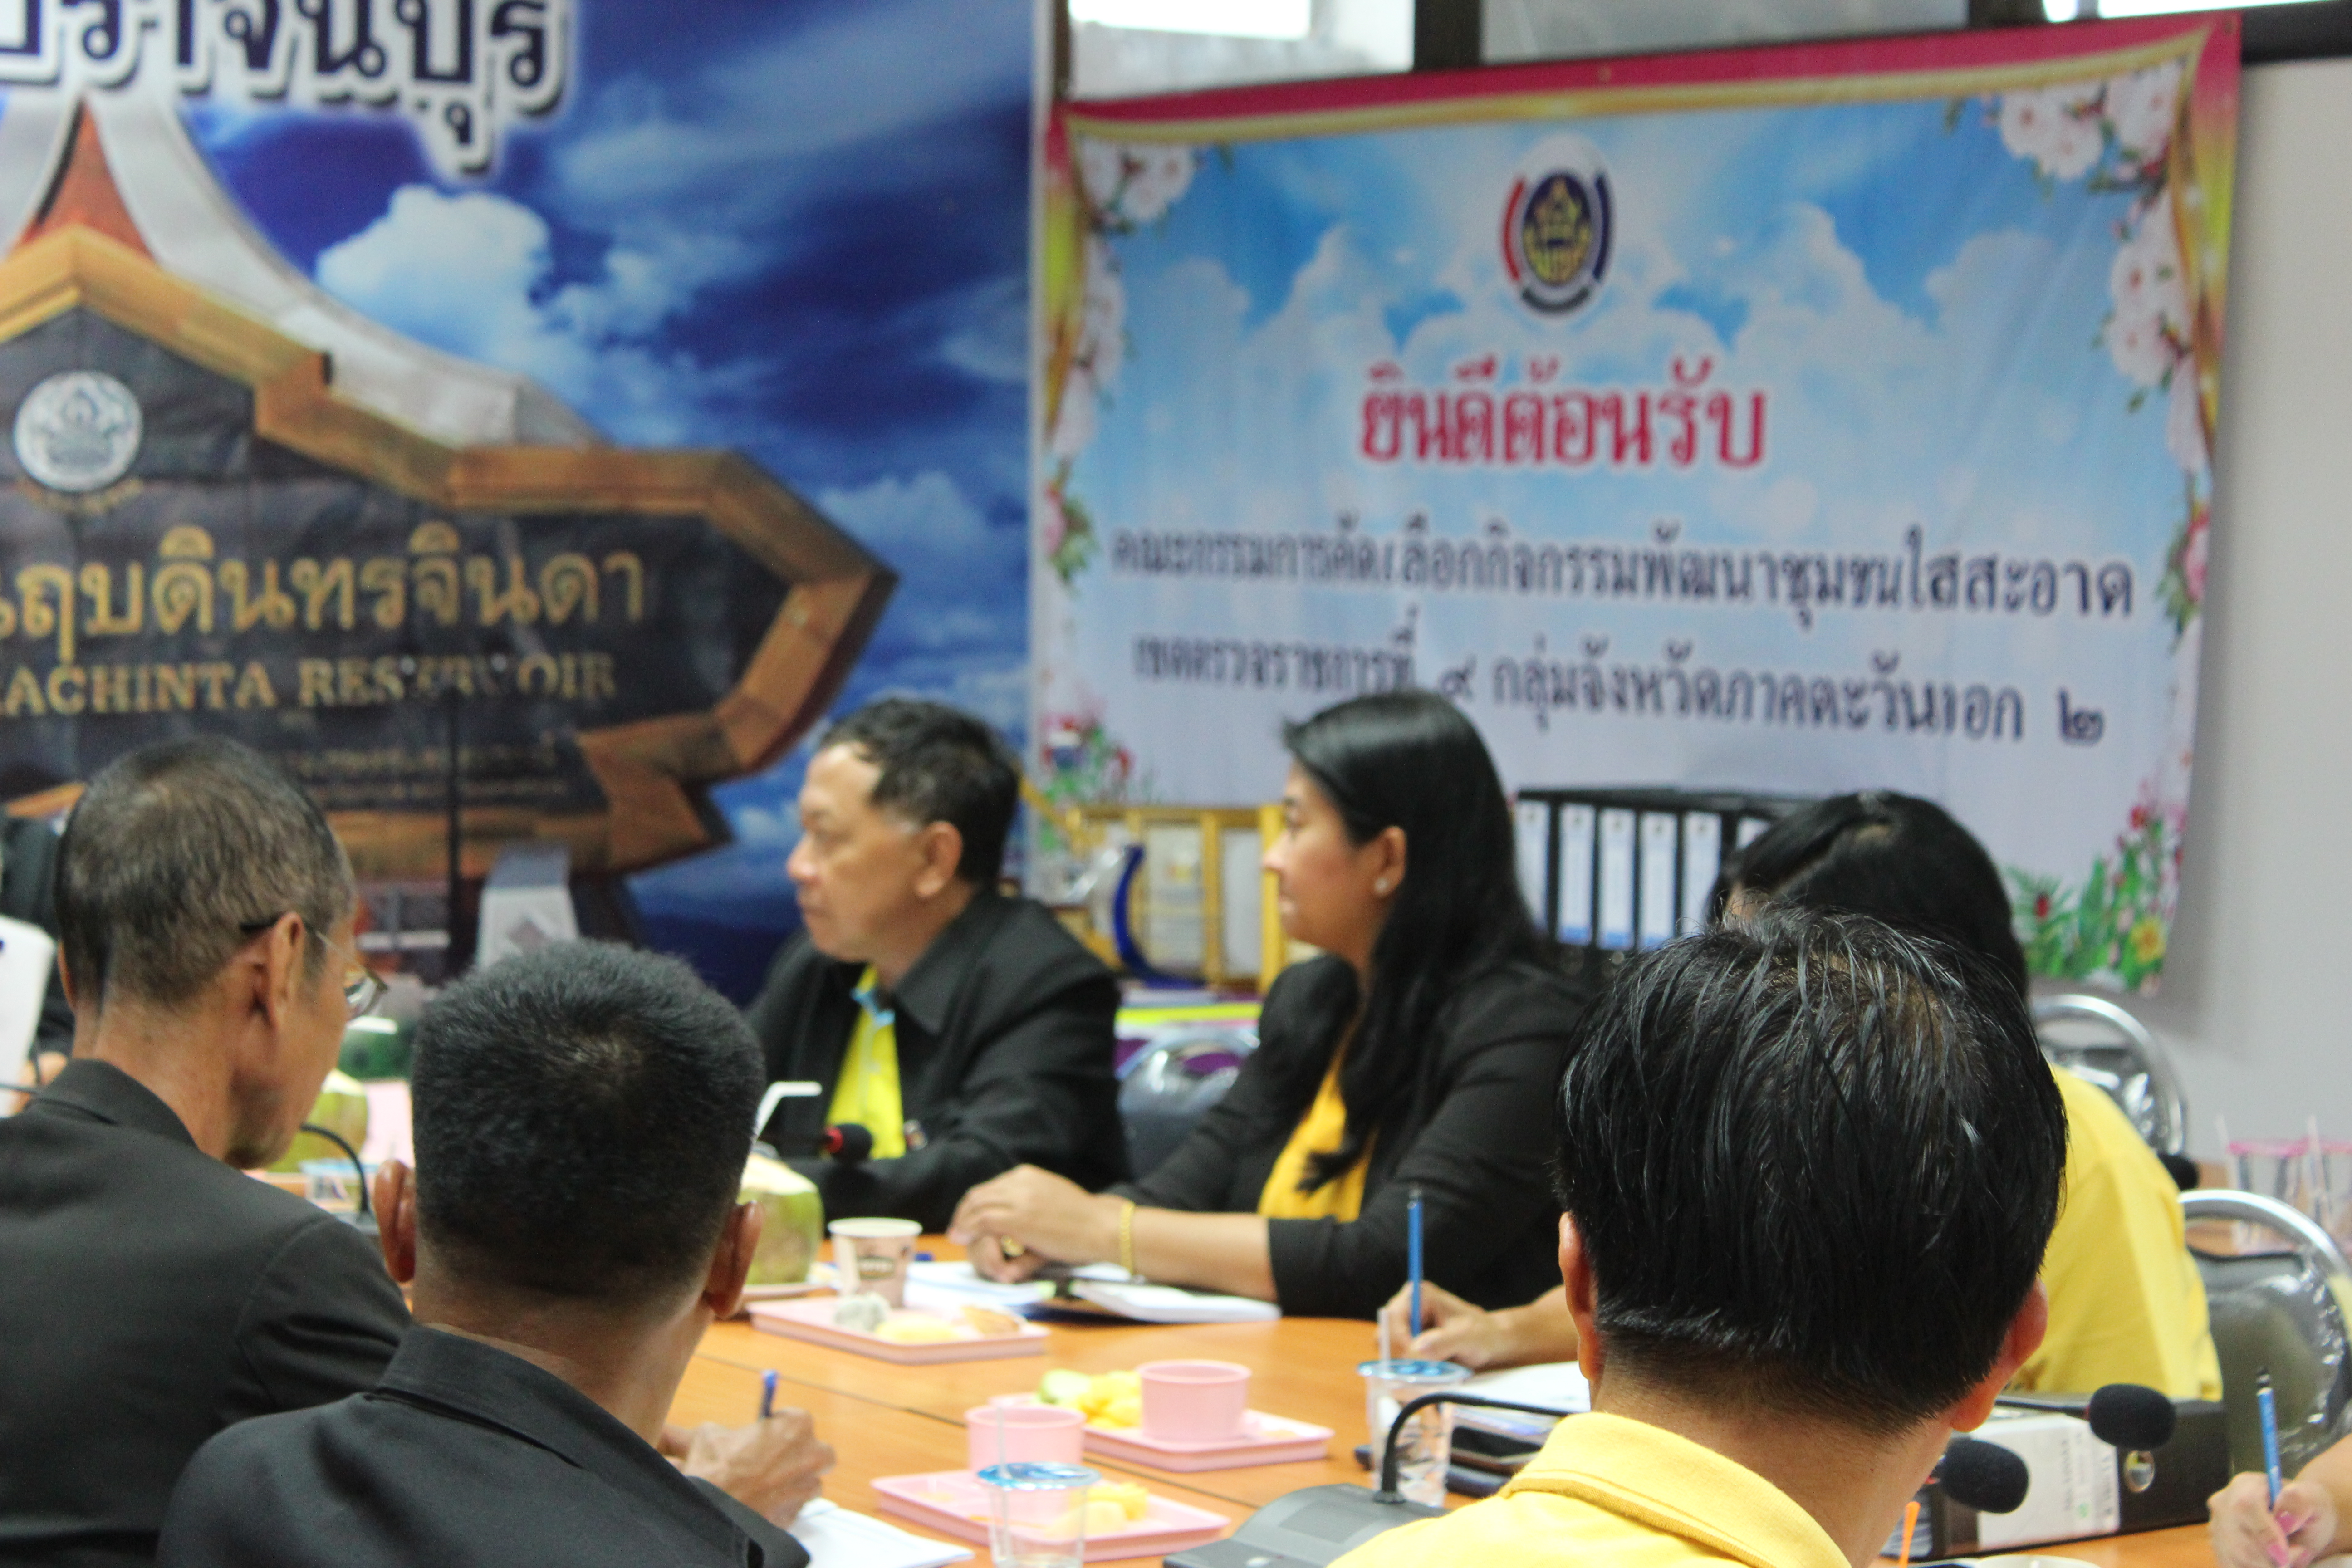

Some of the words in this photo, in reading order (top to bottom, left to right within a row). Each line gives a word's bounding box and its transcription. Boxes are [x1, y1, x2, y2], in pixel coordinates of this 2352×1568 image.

[1360, 352, 1766, 468] ยินดีต้อนรับ
[0, 520, 643, 664] ฤบดินทรจินดา
[0, 662, 277, 717] ACHINTA
[2058, 686, 2106, 745] ๒
